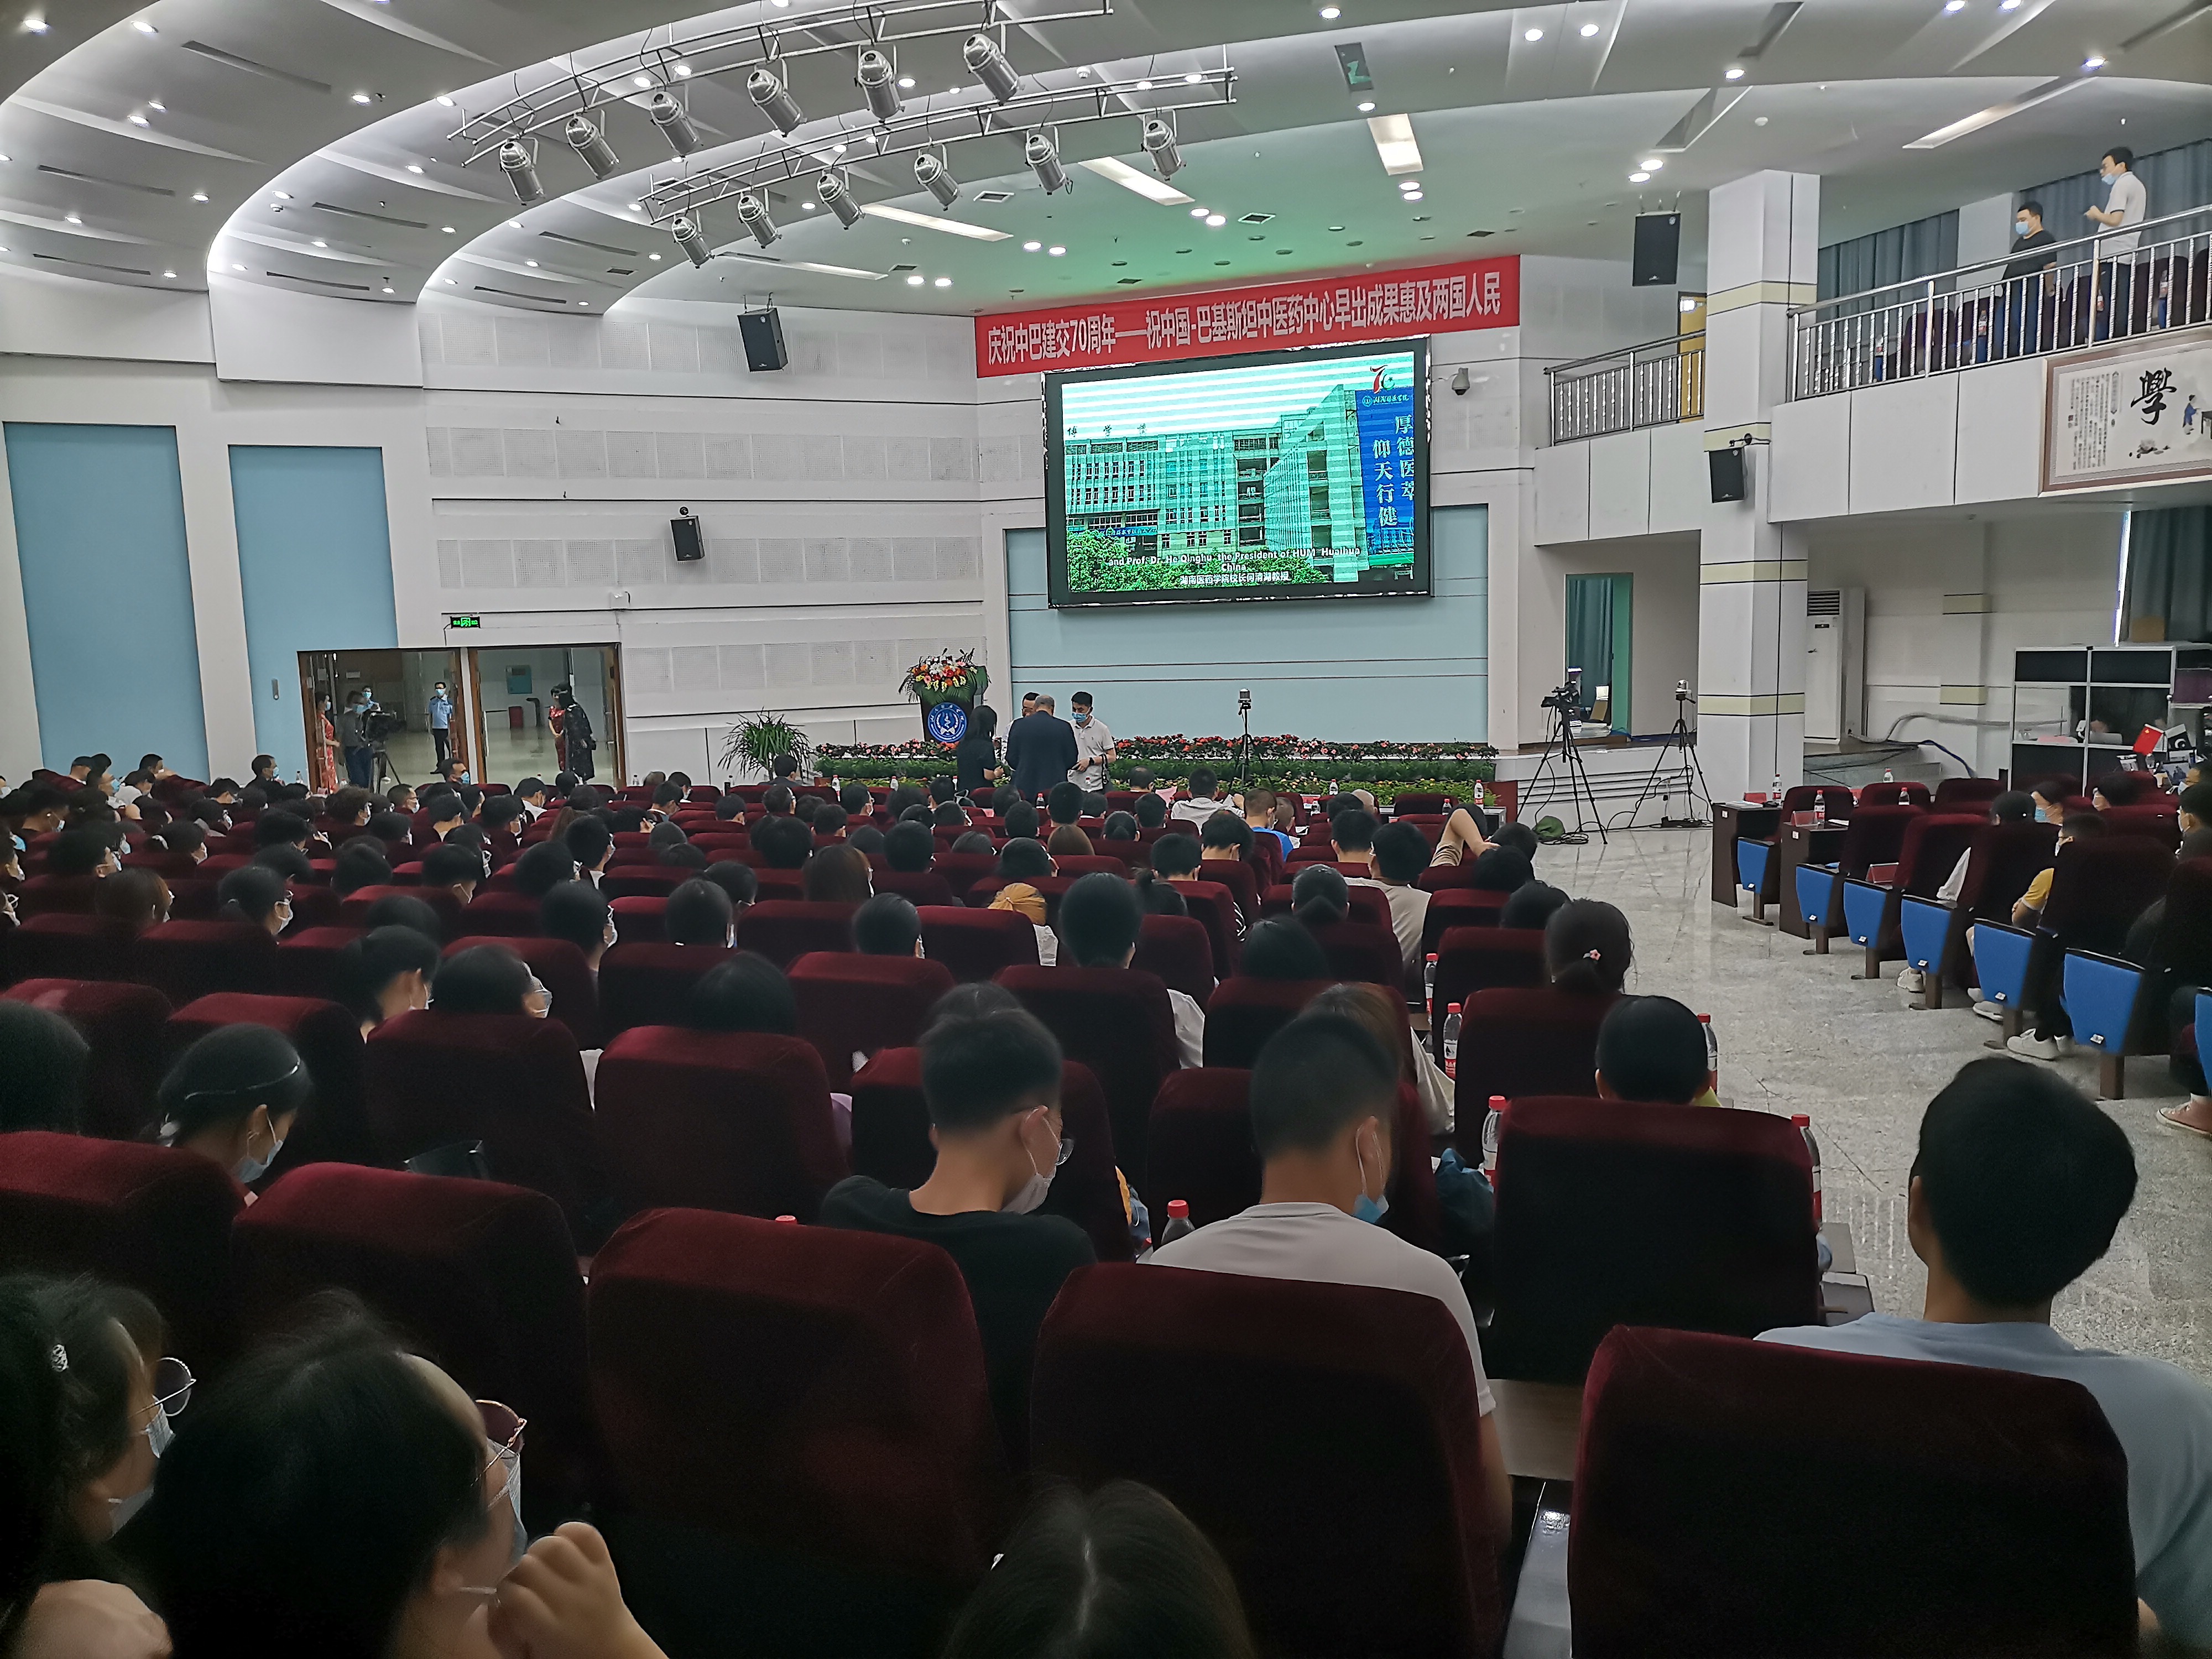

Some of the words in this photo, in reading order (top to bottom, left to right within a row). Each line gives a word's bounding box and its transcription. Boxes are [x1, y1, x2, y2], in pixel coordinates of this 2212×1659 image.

[1109, 557, 1124, 566] and
[1166, 555, 1178, 563] He
[1217, 552, 1232, 561] the
[1235, 550, 1278, 561] President
[1280, 549, 1290, 559] of
[1222, 563, 1246, 572] China
